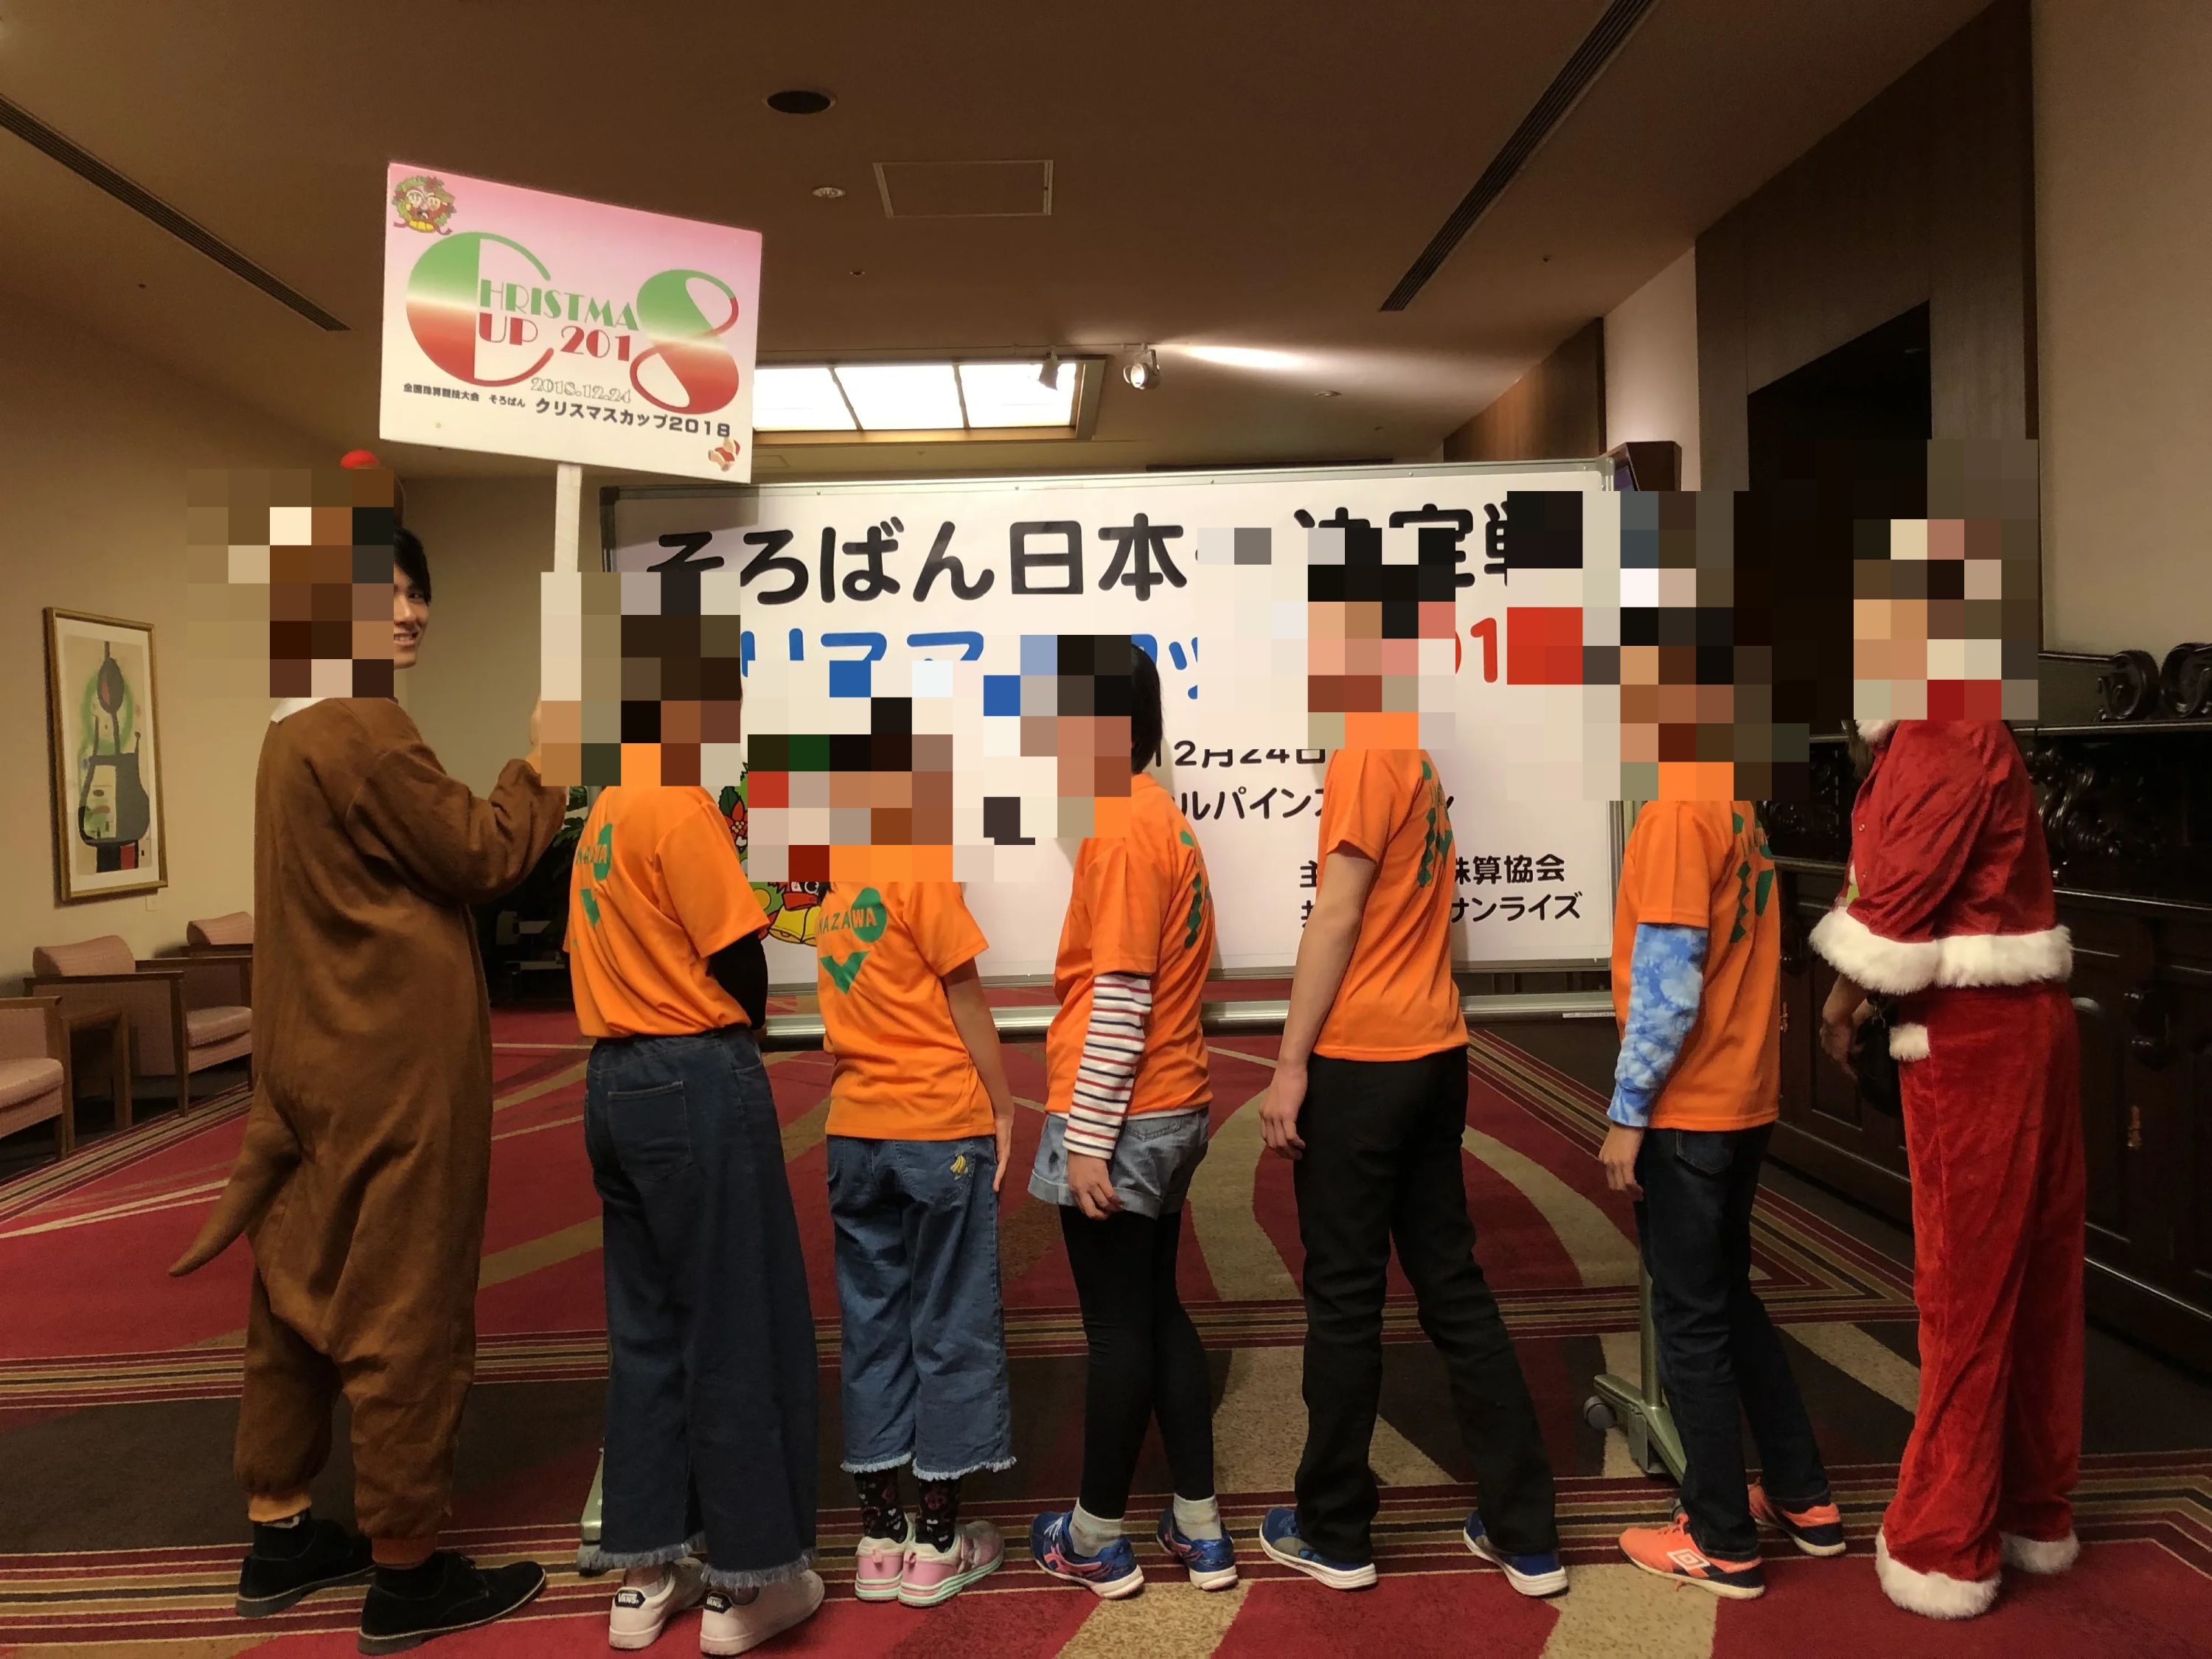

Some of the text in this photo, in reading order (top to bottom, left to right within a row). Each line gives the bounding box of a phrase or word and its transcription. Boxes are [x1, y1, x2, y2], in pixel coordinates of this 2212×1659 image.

[530, 377, 631, 403] 2018.12.24
[489, 394, 526, 408] そろばん
[618, 1593, 639, 1604] VANS
